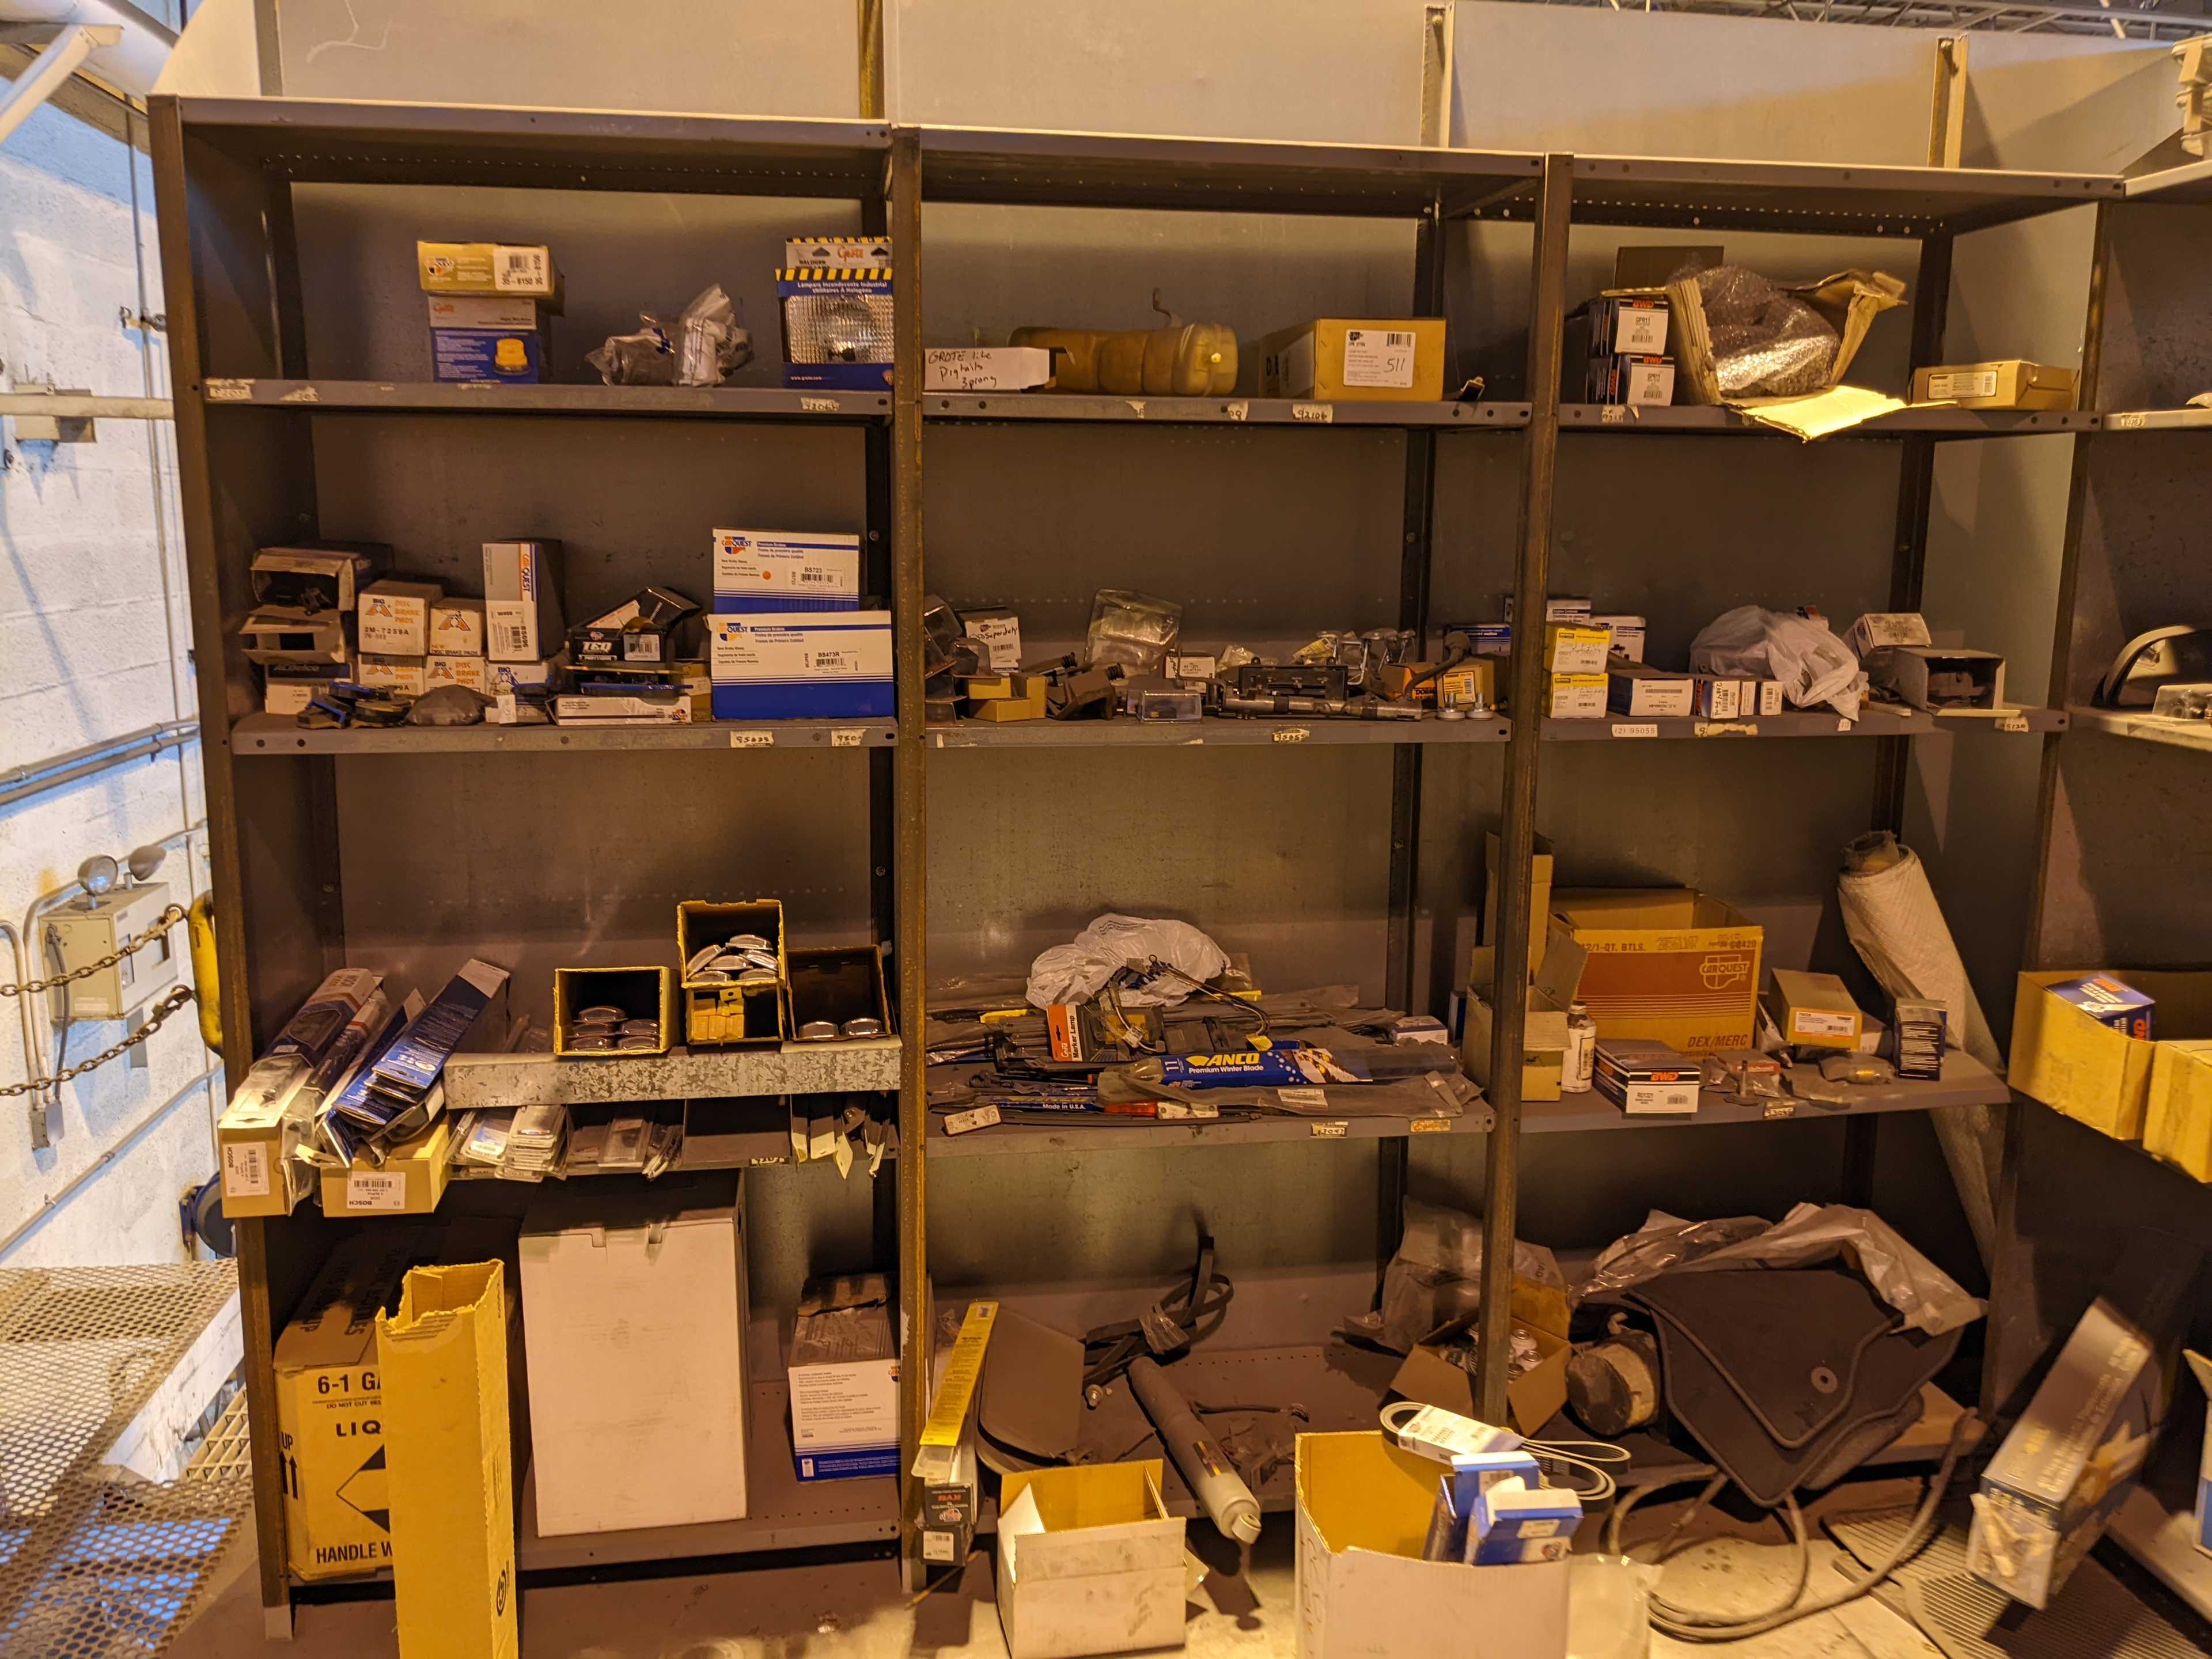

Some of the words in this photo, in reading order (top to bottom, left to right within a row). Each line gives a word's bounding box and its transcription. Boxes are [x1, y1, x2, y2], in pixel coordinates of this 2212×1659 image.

[1633, 300, 1654, 308] BWD
[928, 350, 966, 364] GROTE
[1643, 356, 1662, 365] BWD
[1384, 357, 1406, 373] 511
[1702, 963, 1748, 974] CARQUEST
[1070, 1036, 1079, 1058] Marker
[1687, 1035, 1748, 1048] DEX/MERC
[1207, 1052, 1260, 1066] ANCO
[1650, 1072, 1679, 1081] BWD
[317, 1374, 349, 1394] 6-1
[336, 1420, 381, 1437] LIQ
[281, 1431, 293, 1451] UP
[316, 1542, 377, 1564] HANDLE
